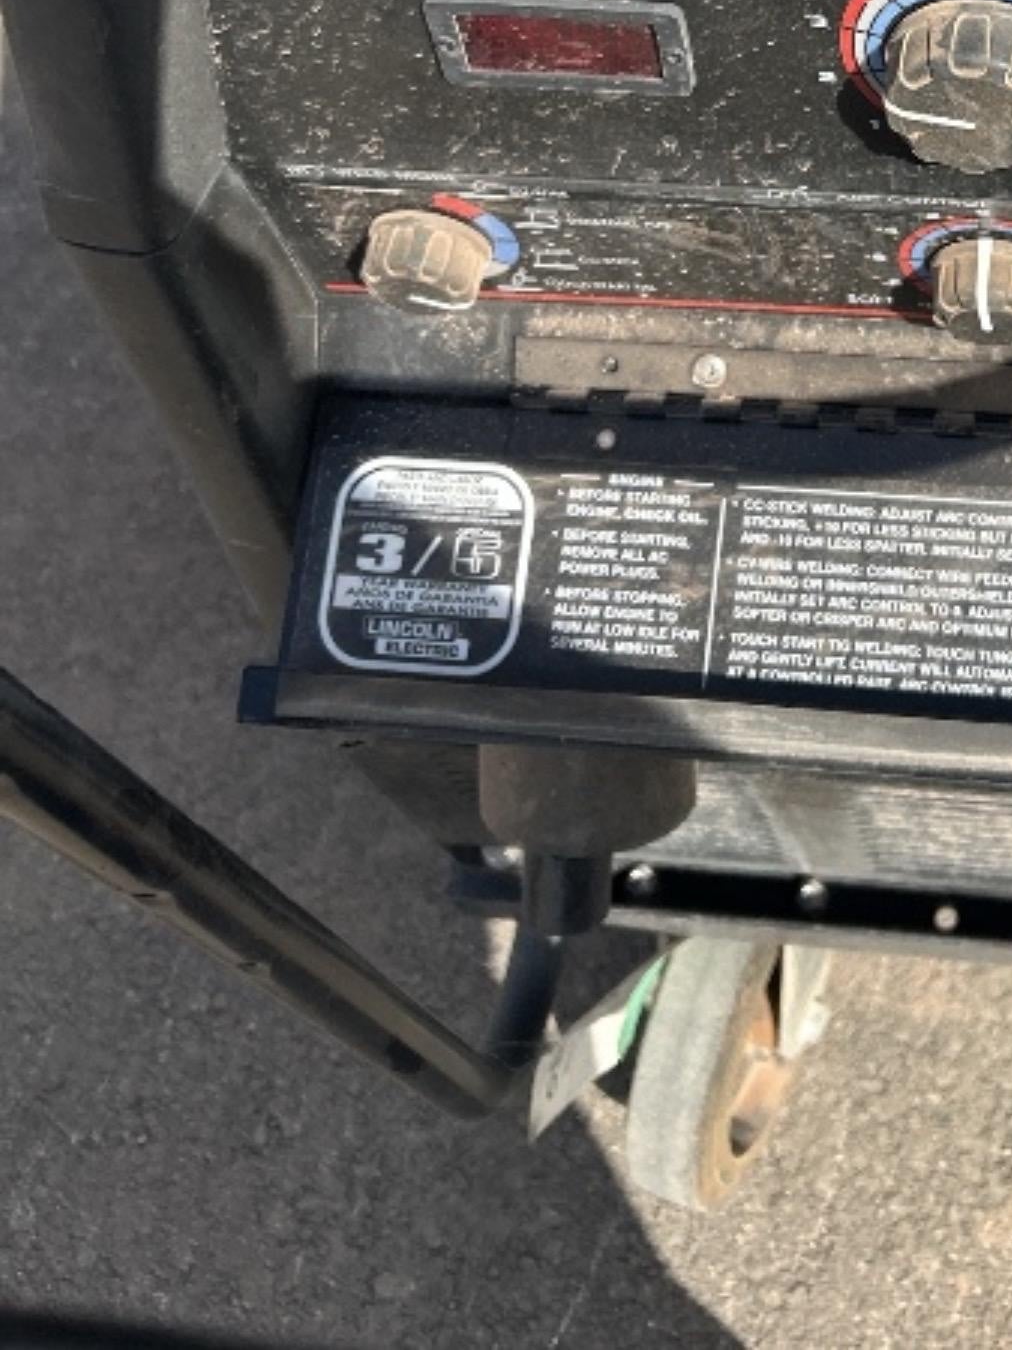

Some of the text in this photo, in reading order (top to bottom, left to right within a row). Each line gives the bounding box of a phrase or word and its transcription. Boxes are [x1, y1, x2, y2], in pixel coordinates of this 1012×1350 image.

[355, 533, 406, 574] 3
[553, 602, 602, 617] ALLOW
[367, 617, 453, 639] LINCOLN
[604, 623, 636, 637] LOW
[385, 640, 460, 657] ELECTRIC
